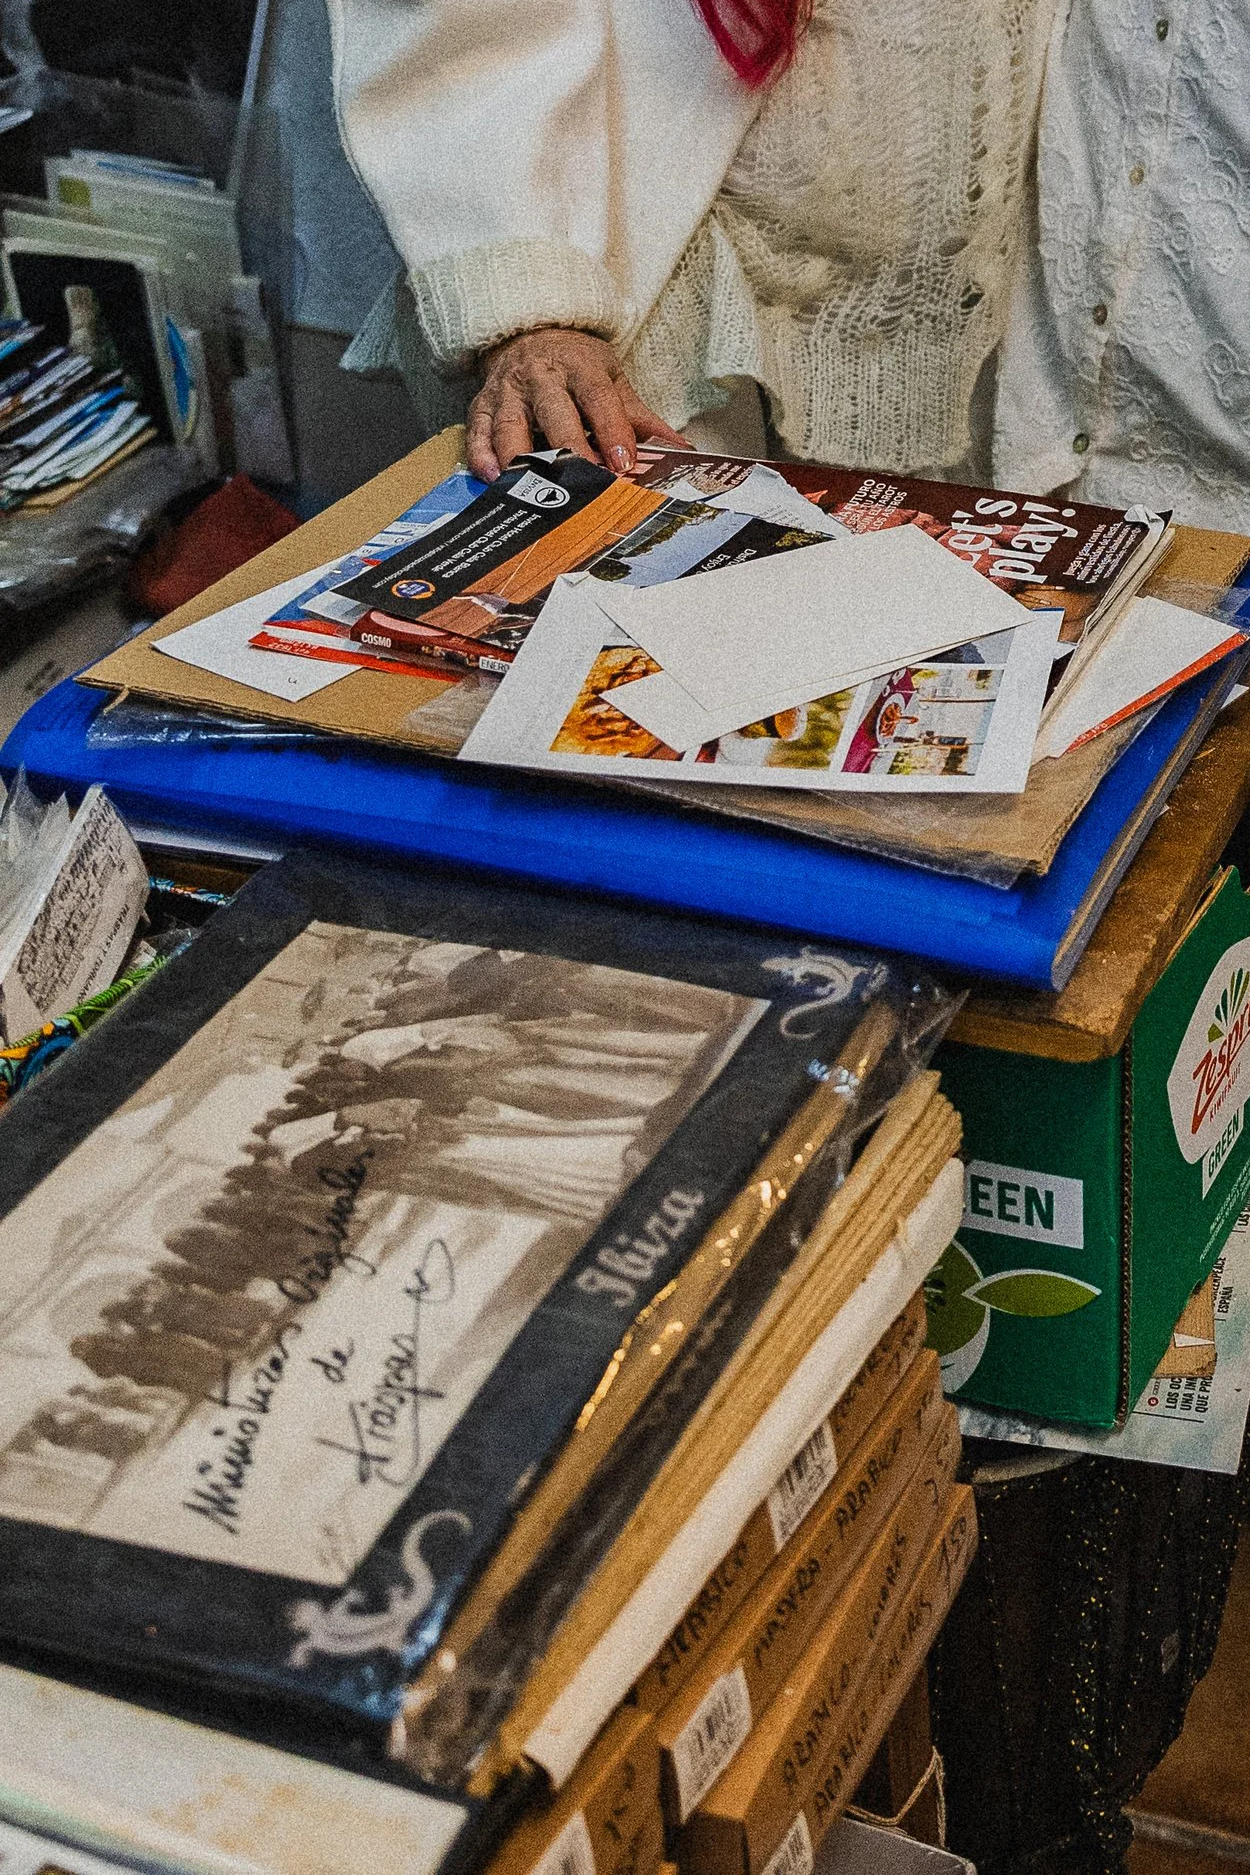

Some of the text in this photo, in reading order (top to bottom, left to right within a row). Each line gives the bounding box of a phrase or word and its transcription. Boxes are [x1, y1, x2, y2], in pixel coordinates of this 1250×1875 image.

[877, 485, 899, 508] TAROT
[882, 491, 908, 518] ASTROS
[987, 501, 1079, 585] play!
[361, 632, 392, 648] COSMO
[1208, 1062, 1242, 1123] KIWIFRUIT
[1208, 1107, 1241, 1179] GREEN
[963, 1173, 1054, 1231] EEN
[576, 1189, 705, 1307] Ibiza
[1217, 1285, 1234, 1315] ESPAÑA
[312, 1337, 355, 1384] de
[1165, 1385, 1178, 1410] LOS
[1180, 1387, 1193, 1412] UNA
[1195, 1389, 1209, 1414] QUE
